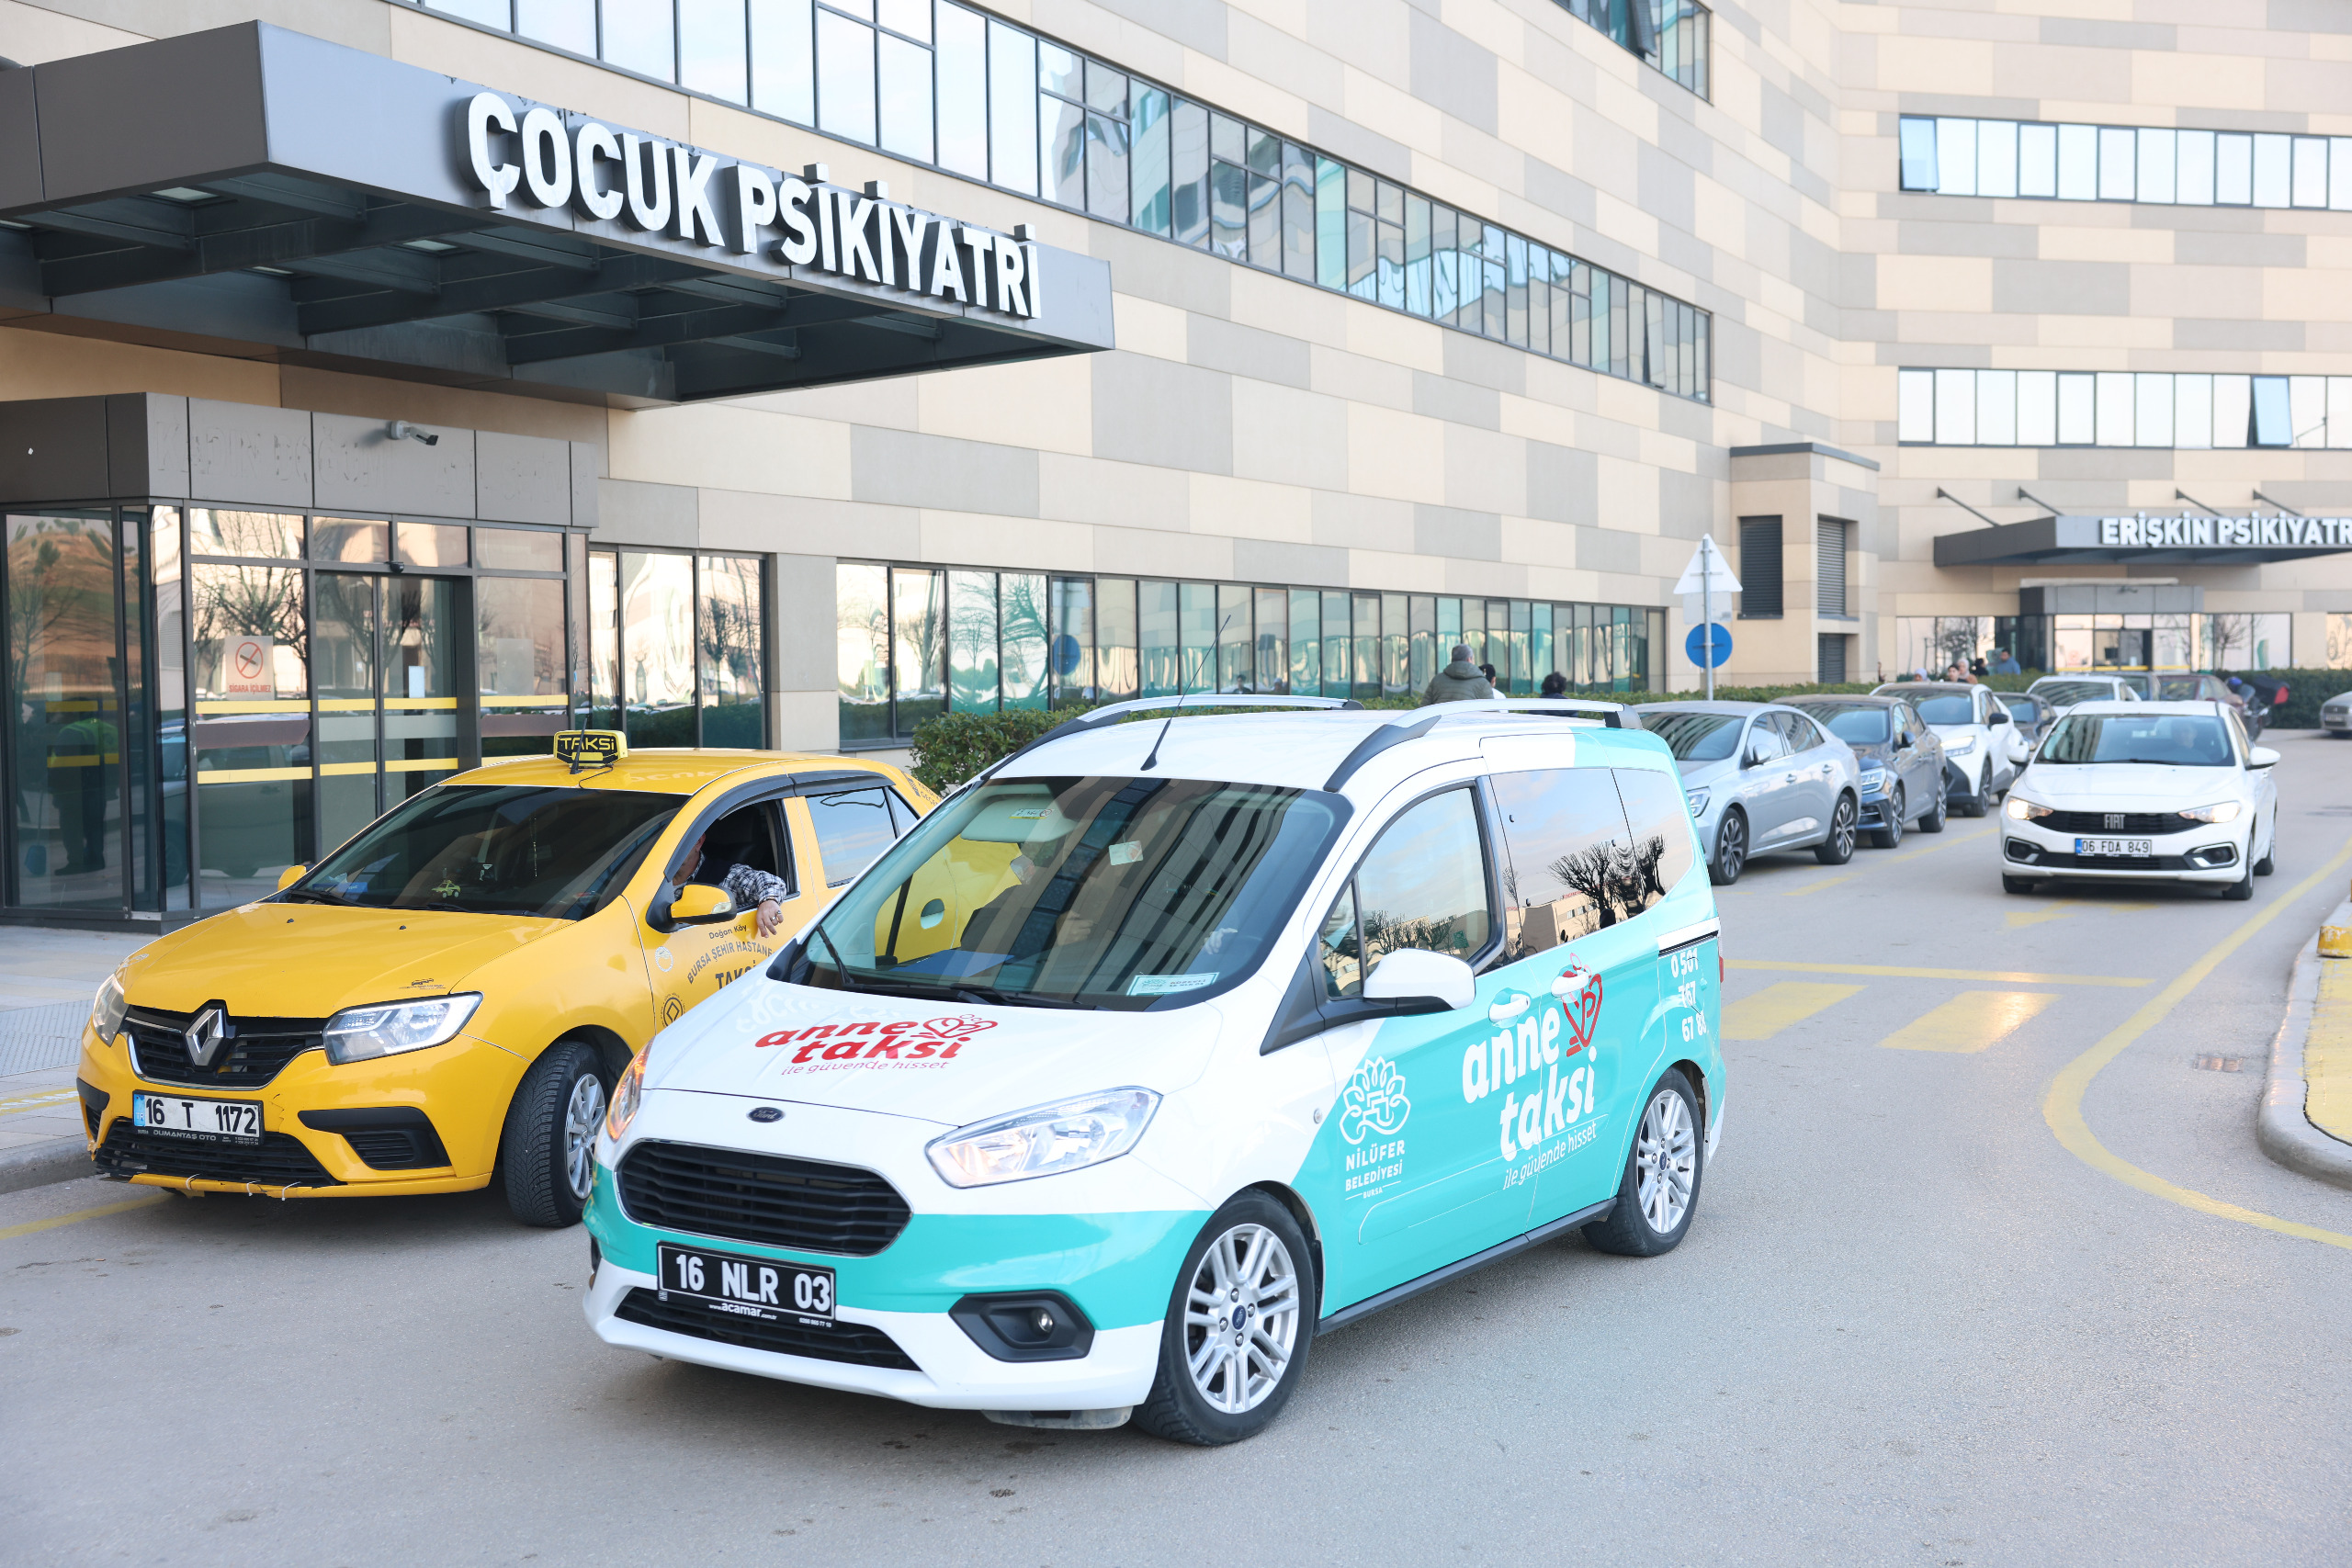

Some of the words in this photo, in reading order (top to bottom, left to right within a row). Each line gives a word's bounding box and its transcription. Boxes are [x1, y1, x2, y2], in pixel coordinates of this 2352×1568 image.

[467, 91, 726, 247] ÇOCUK
[736, 163, 1042, 319] PSİKİYATRİ
[2101, 511, 2211, 547] ERİŞKİN
[228, 683, 249, 693] SİGARA
[250, 683, 272, 694] İÇİLMEZ
[2104, 814, 2125, 829] FIAT
[2082, 840, 2095, 852] 06
[2101, 840, 2121, 852] FDA
[2128, 841, 2149, 852] 849
[708, 928, 733, 940] Doğan
[734, 924, 747, 933] Köy
[686, 953, 712, 985] BURSA
[711, 940, 735, 963] ŞEHİR
[1671, 954, 1679, 978] 0
[1679, 947, 1699, 976] 501
[1678, 980, 1696, 1008] 767
[754, 1021, 920, 1047] anne
[1681, 1015, 1694, 1042] 67
[790, 1034, 972, 1065] taksi
[1462, 1007, 1561, 1104] anne
[780, 1064, 804, 1076] ile
[808, 1060, 888, 1075] güvende
[892, 1060, 950, 1070] hisset
[145, 1098, 165, 1125] 16
[181, 1101, 194, 1128] T
[215, 1105, 257, 1134] 1172
[1499, 1045, 1598, 1162] taksi
[198, 1134, 217, 1142] OTO
[1345, 1139, 1406, 1172] NİLÜFER
[1502, 1168, 1518, 1190] ile
[1519, 1138, 1566, 1186] güvende
[1567, 1122, 1597, 1154] hisset
[1345, 1158, 1403, 1192] BELEDİYESİ
[1363, 1186, 1384, 1199] BURSA
[676, 1254, 706, 1292] 16
[721, 1261, 779, 1304] NLR
[794, 1272, 831, 1312] 03
